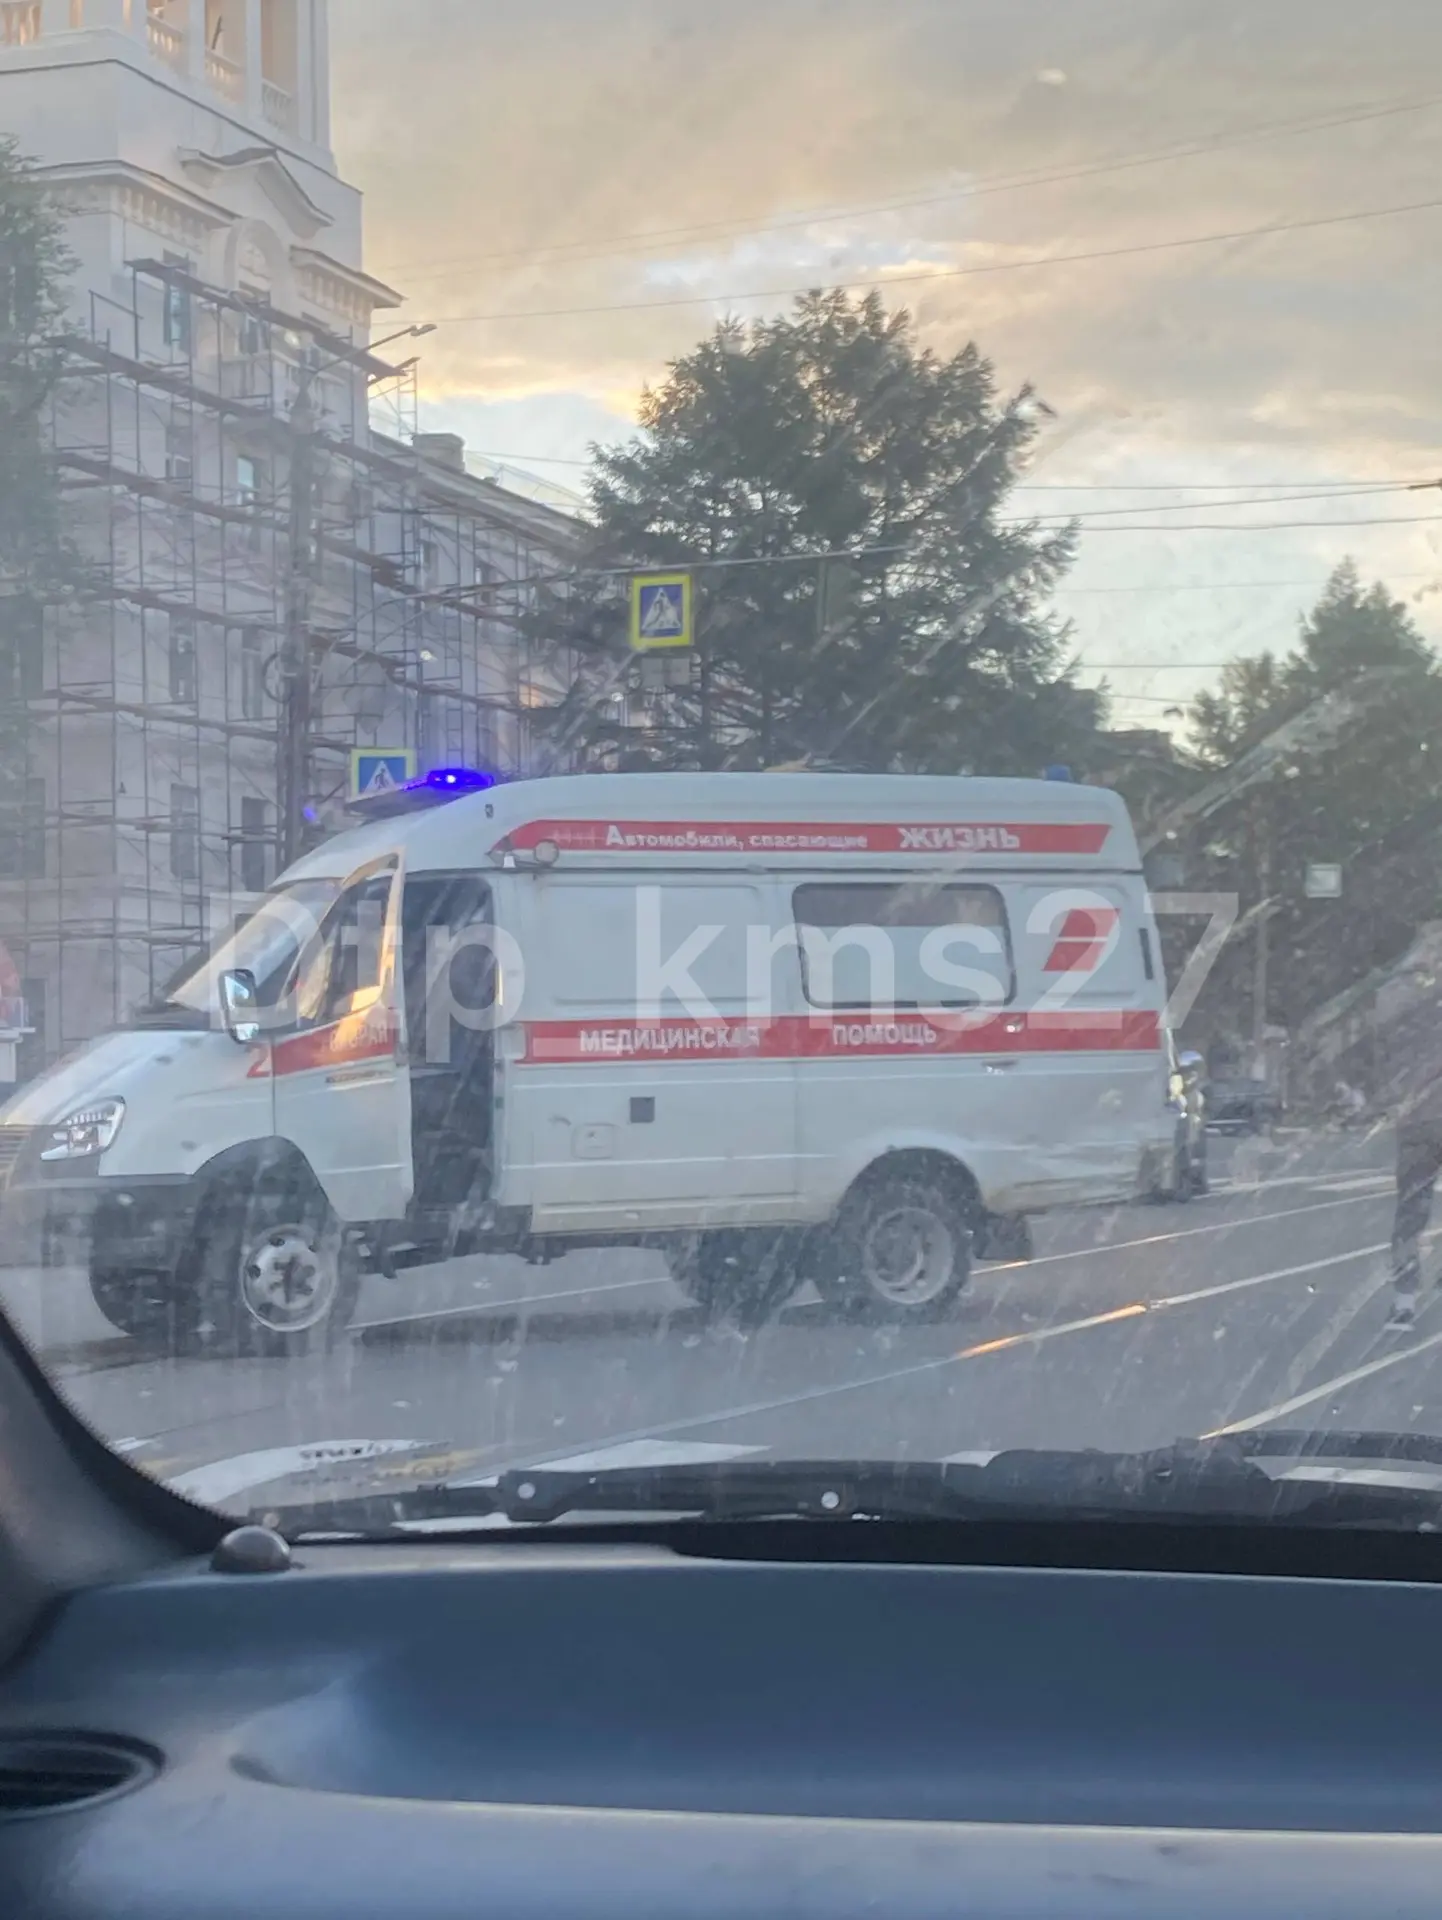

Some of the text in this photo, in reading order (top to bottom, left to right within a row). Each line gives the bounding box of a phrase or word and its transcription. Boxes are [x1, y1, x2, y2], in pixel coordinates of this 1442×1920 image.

[606, 825, 1020, 851] Автомобили, спасающие ЖИЗНЬ
[831, 1024, 938, 1047] ПОМОЩЬ
